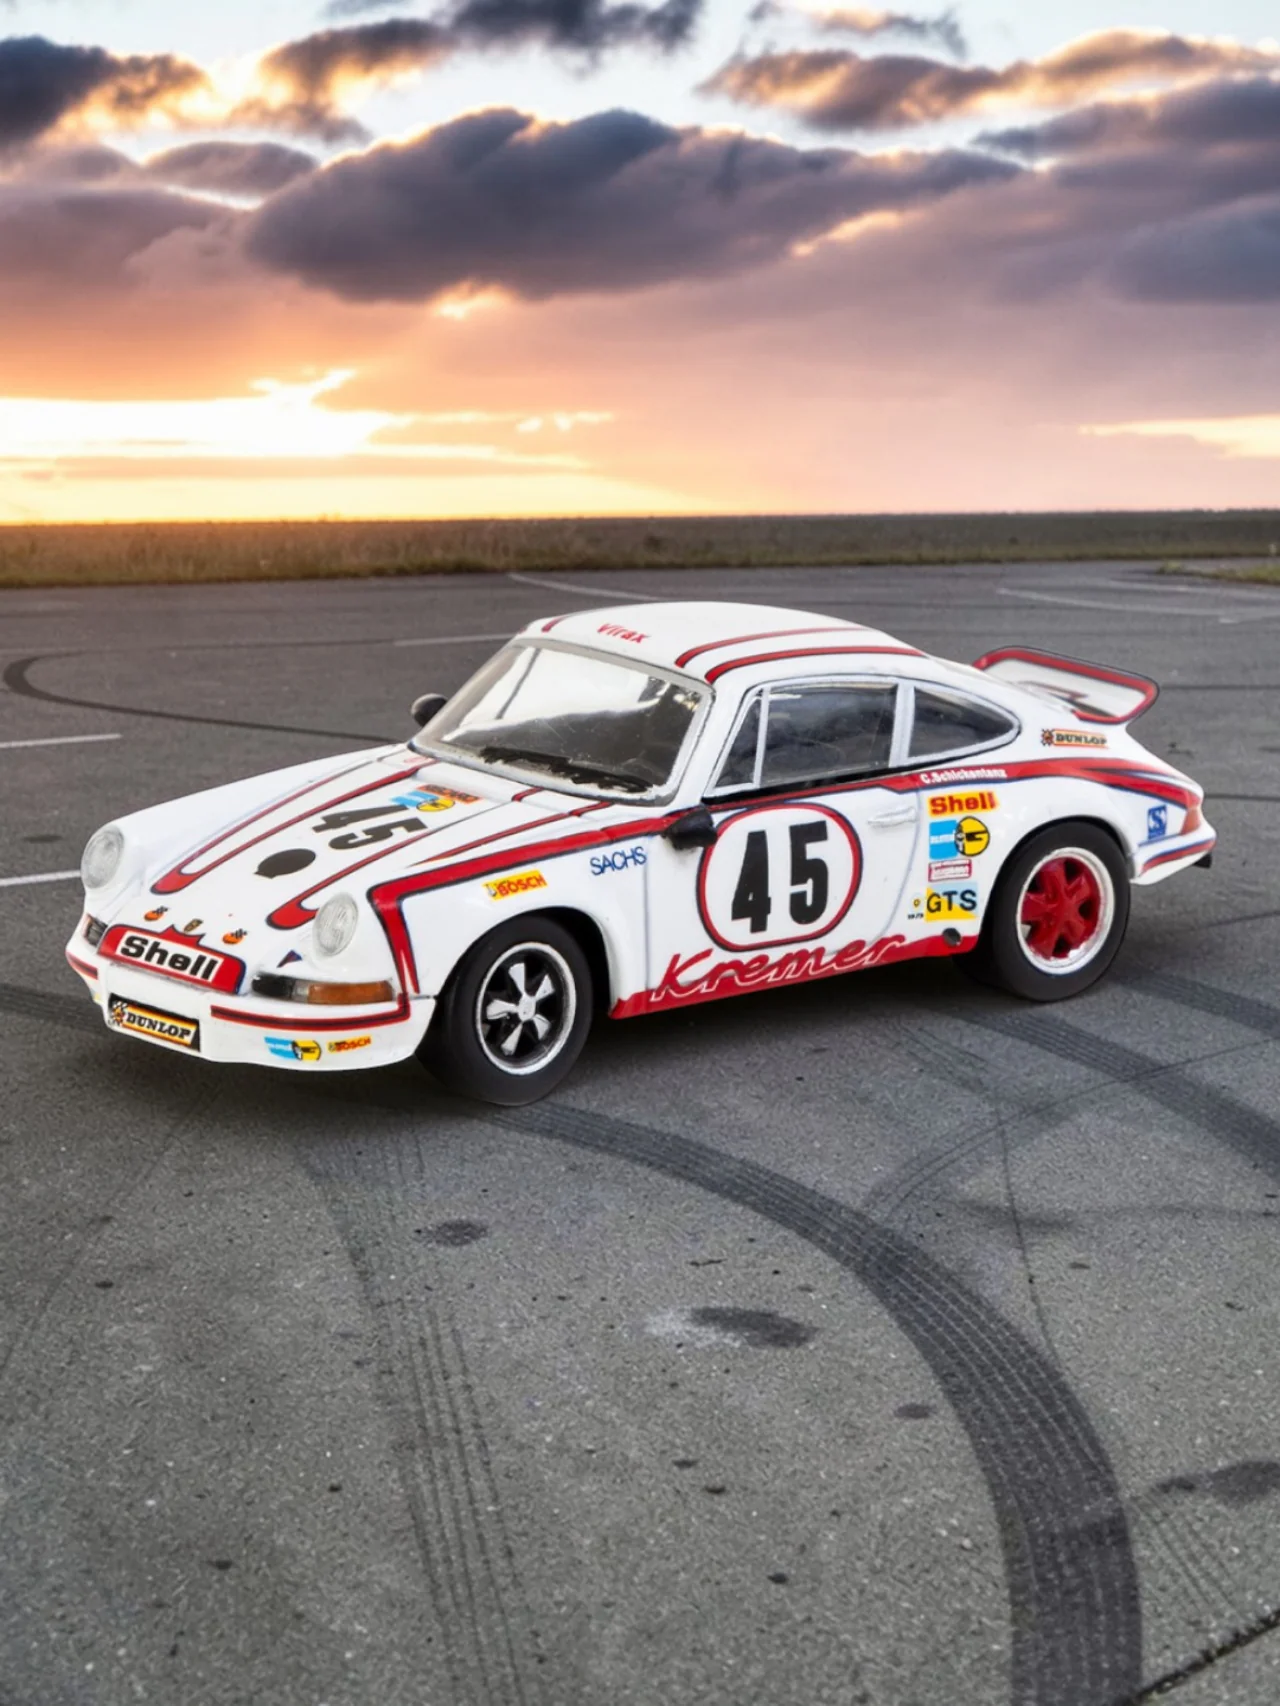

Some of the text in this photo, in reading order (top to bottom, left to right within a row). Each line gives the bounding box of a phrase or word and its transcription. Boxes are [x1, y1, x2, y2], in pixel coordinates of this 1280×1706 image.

[597, 623, 650, 644] Virax
[1055, 732, 1107, 746] DUNLOP
[930, 792, 996, 815] Shell
[312, 805, 427, 850] 45
[590, 846, 647, 876] SACHS
[497, 873, 548, 897] BOSCH
[731, 820, 829, 933] 45
[926, 889, 977, 914] GTS
[120, 934, 218, 980] Shell
[650, 933, 906, 1002] Kremer
[125, 1012, 191, 1041] DUNLOP
[335, 1036, 372, 1052] BOSCH
